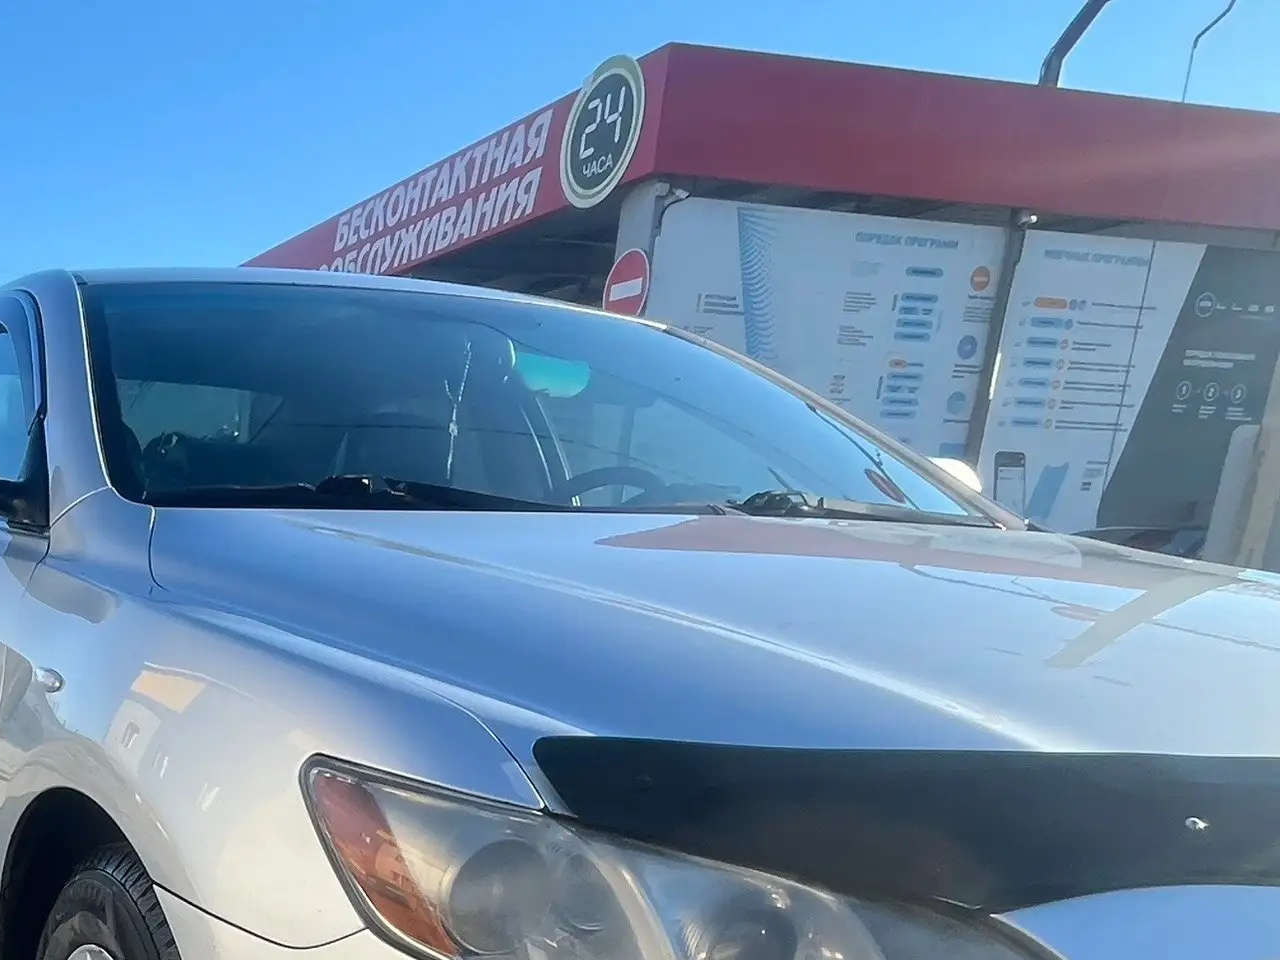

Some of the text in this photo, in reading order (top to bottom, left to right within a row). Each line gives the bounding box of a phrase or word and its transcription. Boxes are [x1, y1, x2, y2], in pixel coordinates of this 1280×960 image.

[579, 86, 626, 160] 24
[582, 153, 614, 179] ЧАСА
[319, 166, 543, 275] БСЛУЖИВАНИЯ
[333, 108, 554, 253] БЕСКОНТАКТНАЯ
